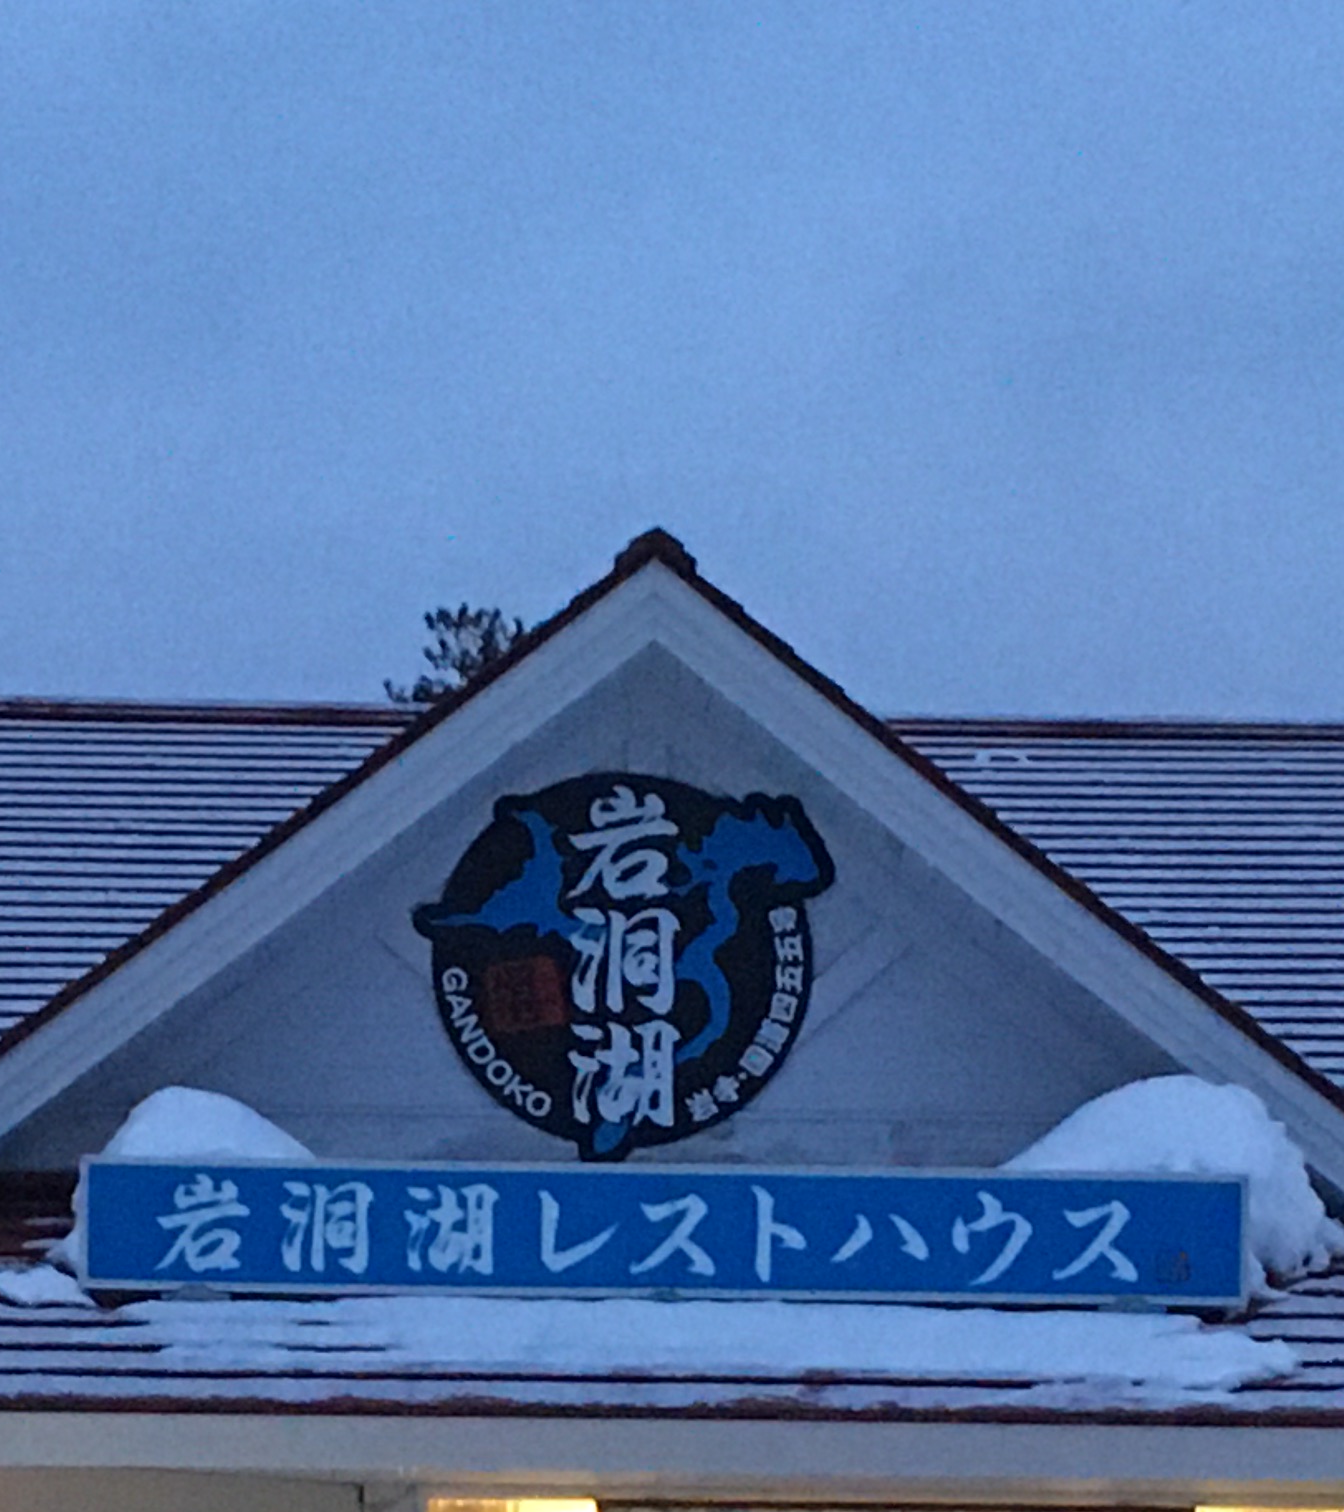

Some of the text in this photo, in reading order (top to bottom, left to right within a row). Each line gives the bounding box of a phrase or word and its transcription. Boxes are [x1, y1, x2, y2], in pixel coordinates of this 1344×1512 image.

[567, 785, 681, 1127] 岩洞湖
[442, 967, 552, 1117] GANDOKO
[154, 1173, 1138, 1286] 岩洞湖レストハウス
